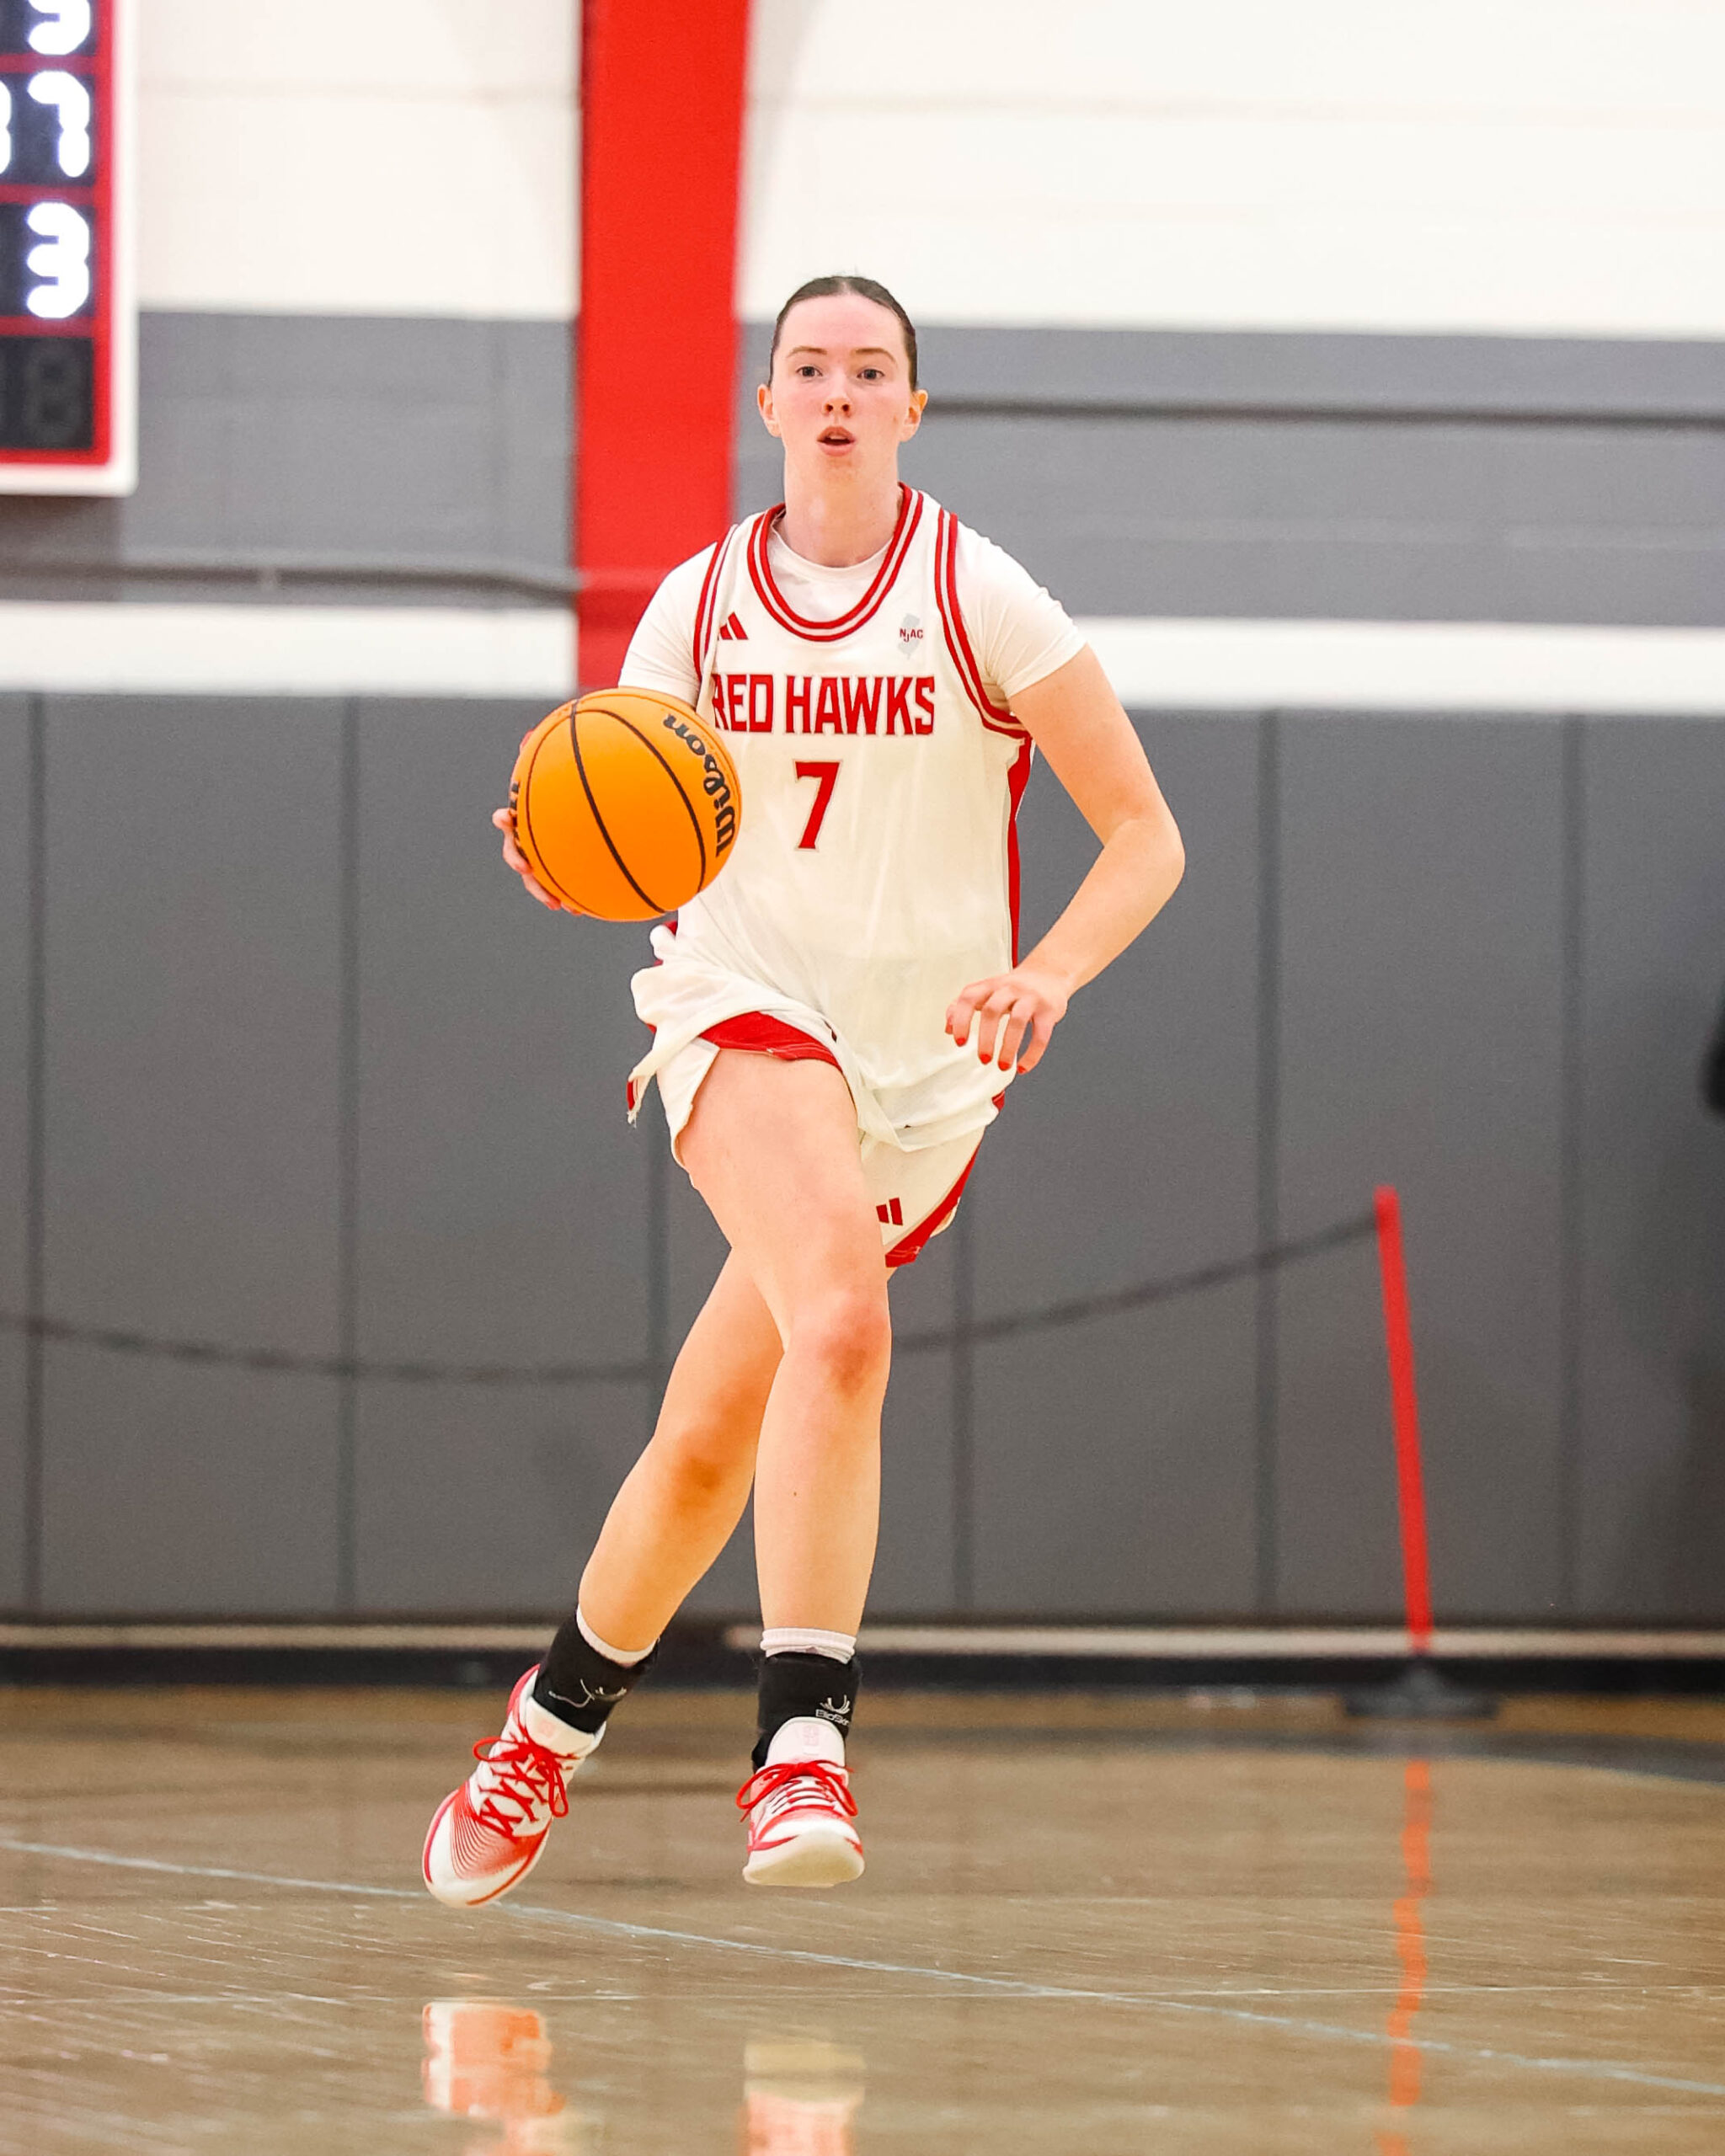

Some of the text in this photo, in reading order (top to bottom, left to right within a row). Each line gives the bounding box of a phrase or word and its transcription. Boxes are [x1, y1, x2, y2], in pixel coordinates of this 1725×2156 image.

[26, 201, 90, 319] 3
[784, 675, 935, 735] HAWKS
[663, 713, 735, 857] Wilson
[795, 760, 841, 850] 7
